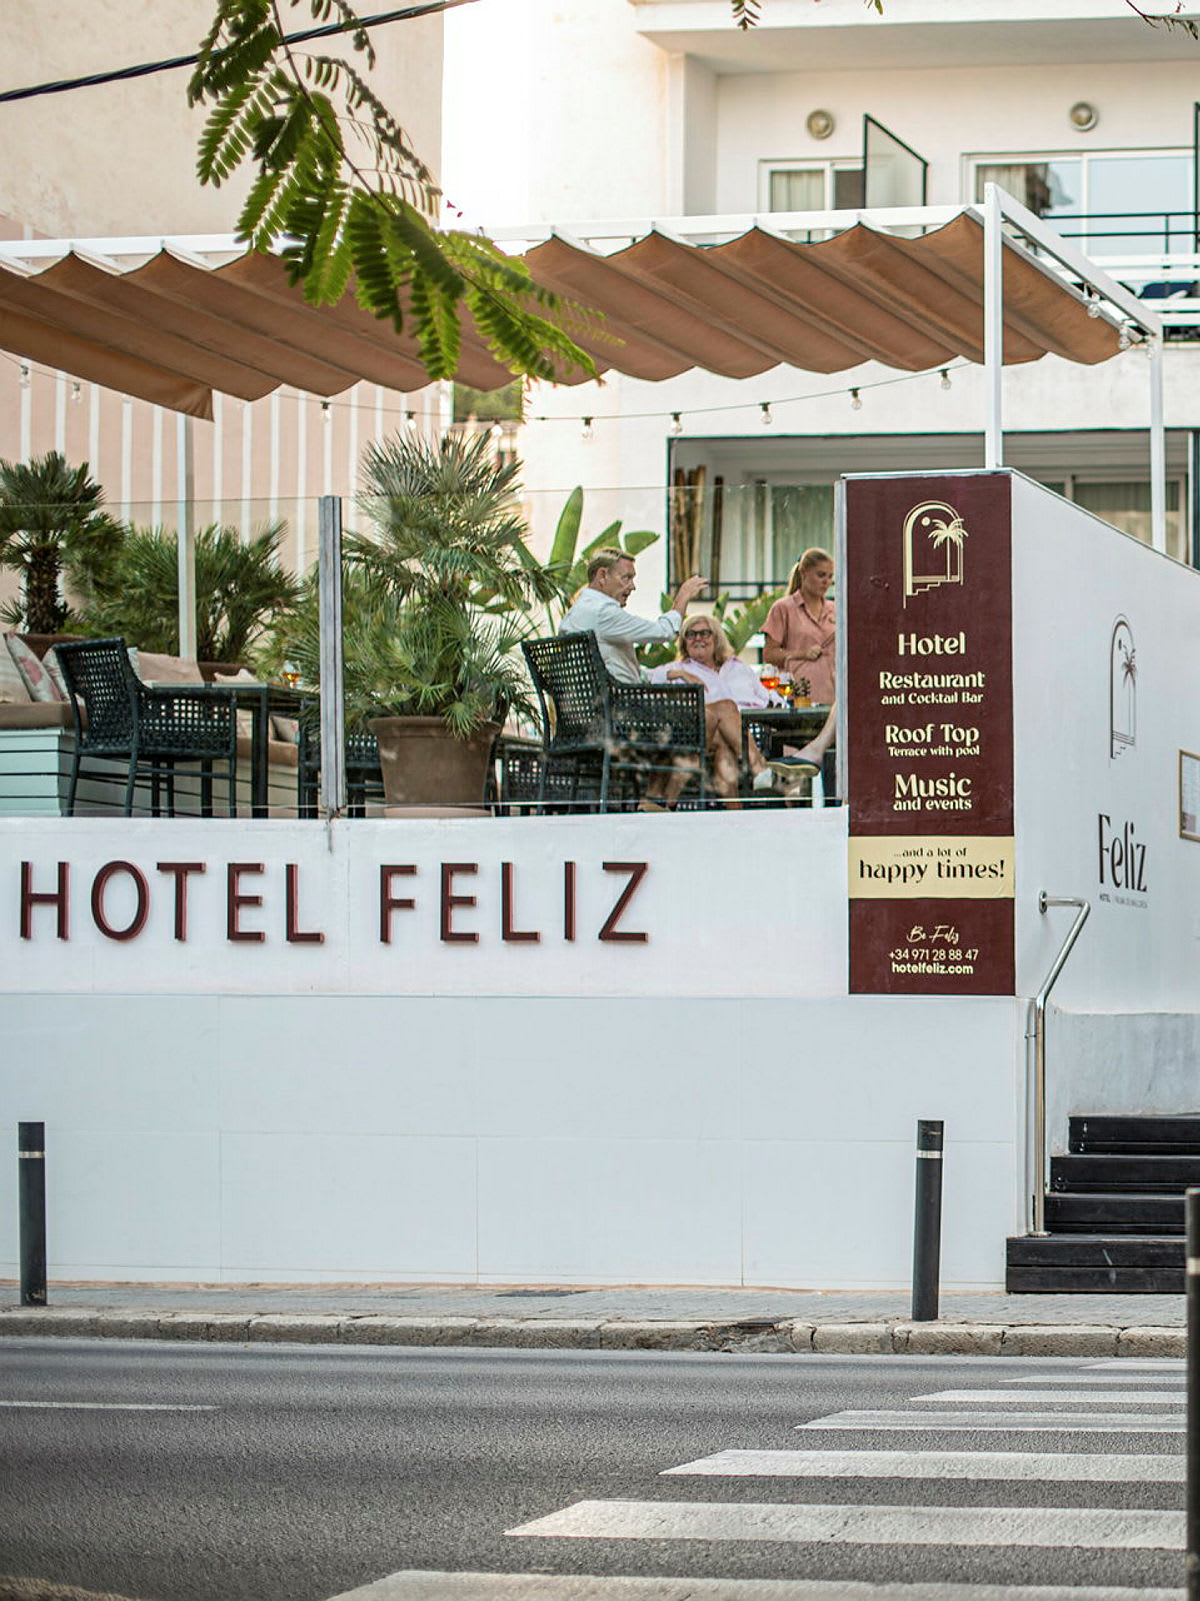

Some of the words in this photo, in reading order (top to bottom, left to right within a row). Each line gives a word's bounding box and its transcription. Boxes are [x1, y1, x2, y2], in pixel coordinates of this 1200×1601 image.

[898, 631, 966, 656] Hotel
[879, 671, 986, 690] Restaurant
[881, 693, 905, 705] and
[908, 691, 958, 704] Cocktail
[961, 692, 983, 704] Bar
[885, 724, 935, 743] Roof
[940, 723, 980, 746] Top
[888, 746, 927, 757] Terrace
[930, 745, 953, 756] with
[955, 745, 980, 758] pool
[894, 772, 972, 798] Music
[893, 798, 921, 811] and
[925, 799, 973, 811] events
[926, 849, 934, 857] a
[937, 847, 951, 857] lot
[955, 847, 967, 857] of
[1098, 813, 1147, 892] Feliz
[859, 860, 928, 883] happy
[937, 859, 1005, 879] times!
[19, 860, 325, 942] HOTEL
[379, 860, 649, 943] FELIZ
[888, 948, 909, 960] +34
[911, 948, 930, 961] 971
[932, 948, 946, 961] 28
[948, 948, 963, 961] 88
[964, 948, 979, 960] 47
[891, 961, 974, 975] hotelfeliz.com
